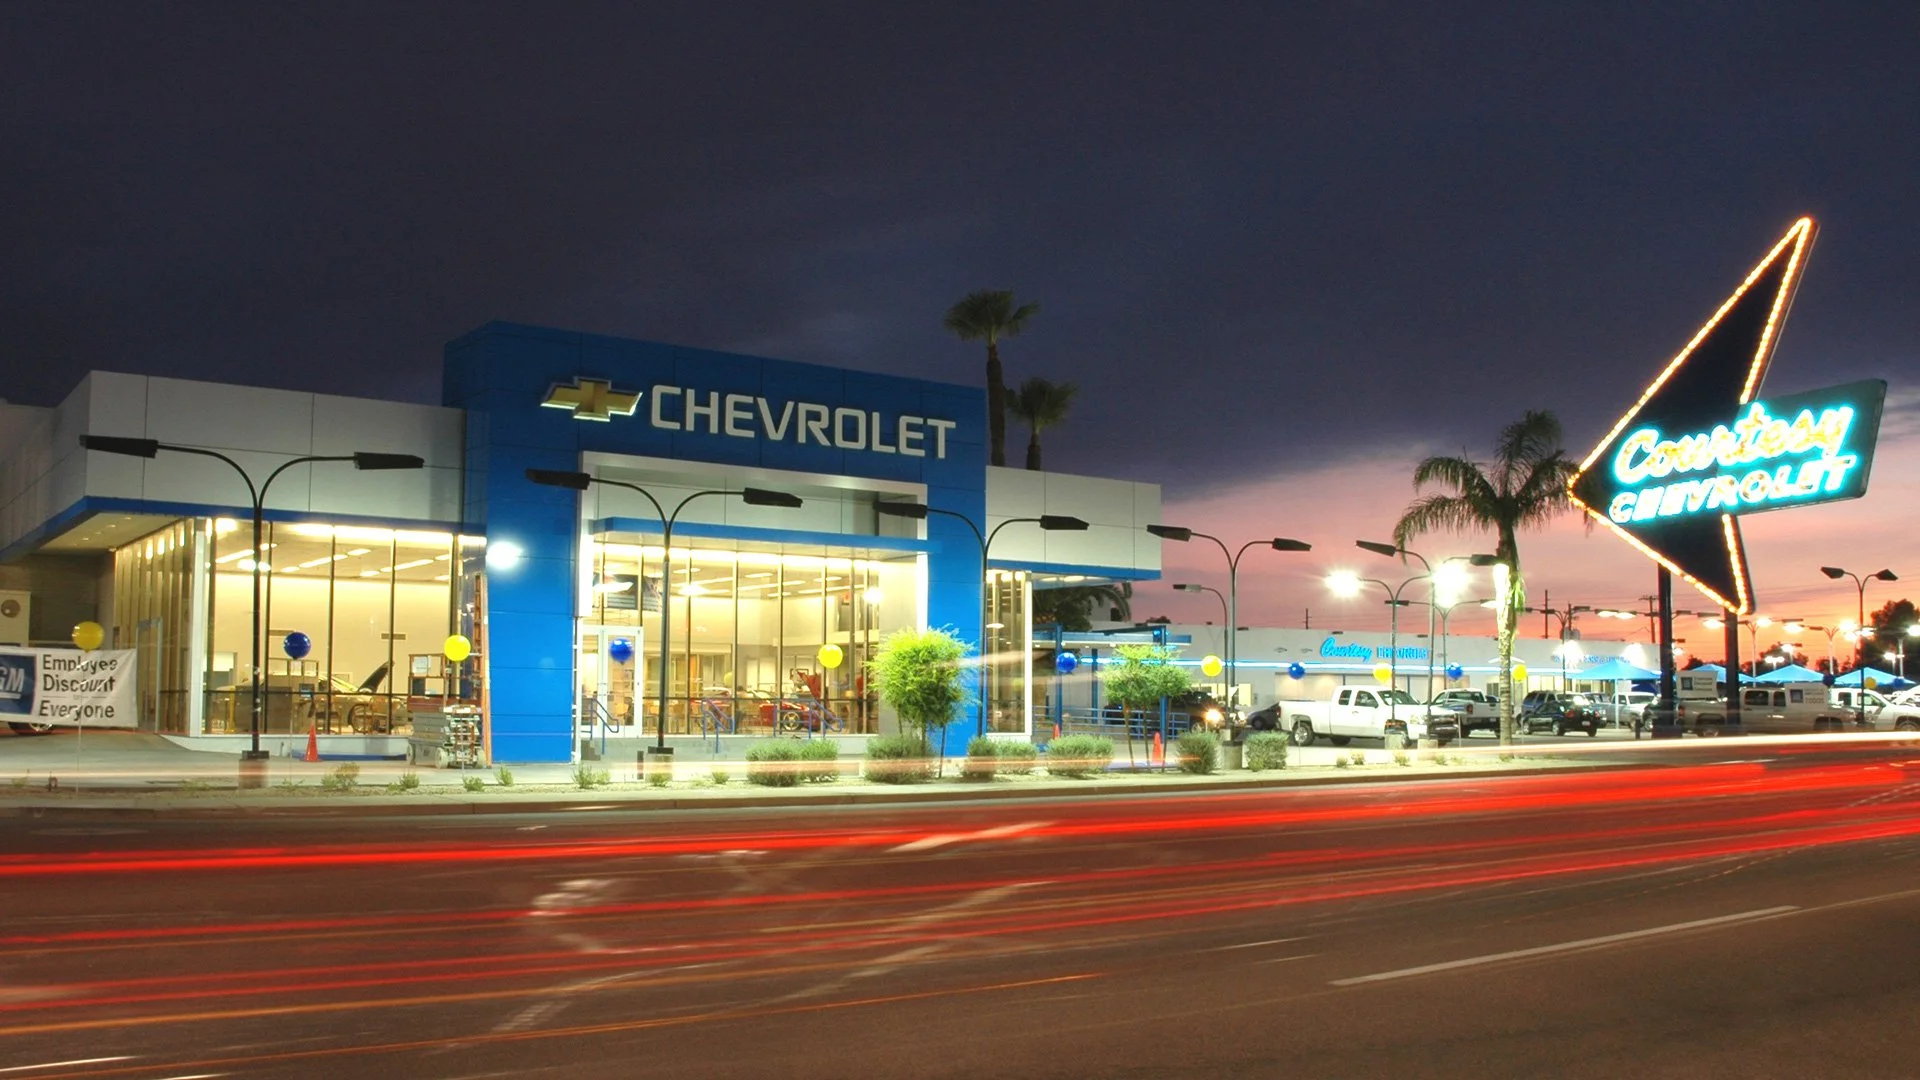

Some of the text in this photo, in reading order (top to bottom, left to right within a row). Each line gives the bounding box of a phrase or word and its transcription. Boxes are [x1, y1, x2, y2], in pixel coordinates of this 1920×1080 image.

[650, 384, 957, 459] CHEVROLET
[1614, 400, 1854, 483] Courtesy
[1609, 455, 1857, 523] CHEVROLET
[1320, 636, 1372, 663] Courtesy
[42, 673, 116, 693] Discount
[39, 700, 115, 721] Everyone
